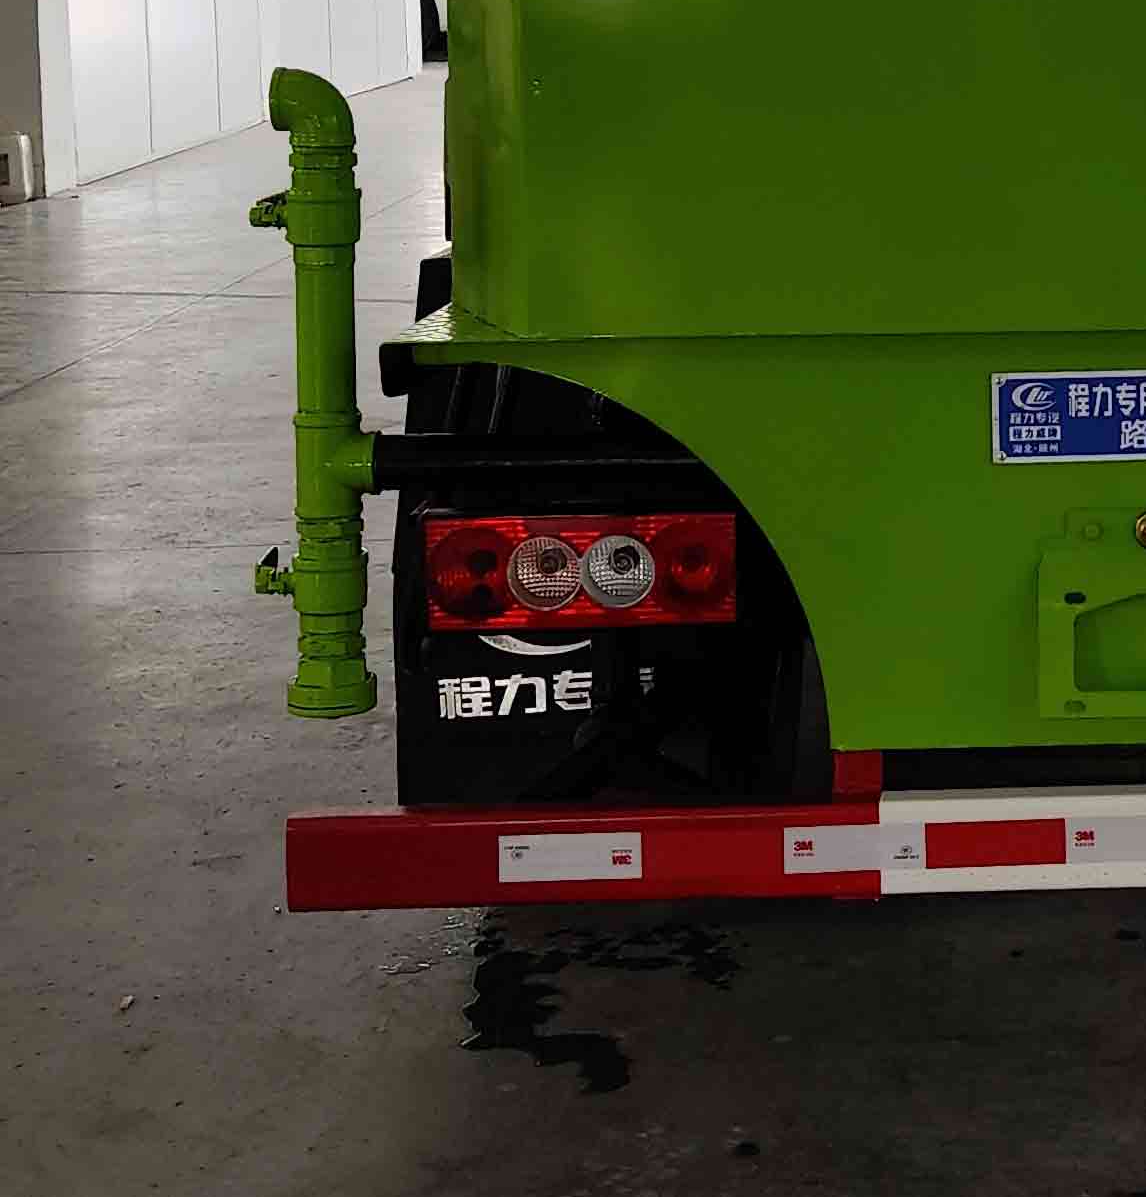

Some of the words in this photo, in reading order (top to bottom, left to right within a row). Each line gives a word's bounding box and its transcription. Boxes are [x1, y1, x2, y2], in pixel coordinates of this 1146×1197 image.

[437, 668, 655, 720] 程力专
[1073, 830, 1095, 842] 3M
[793, 840, 813, 852] 3M
